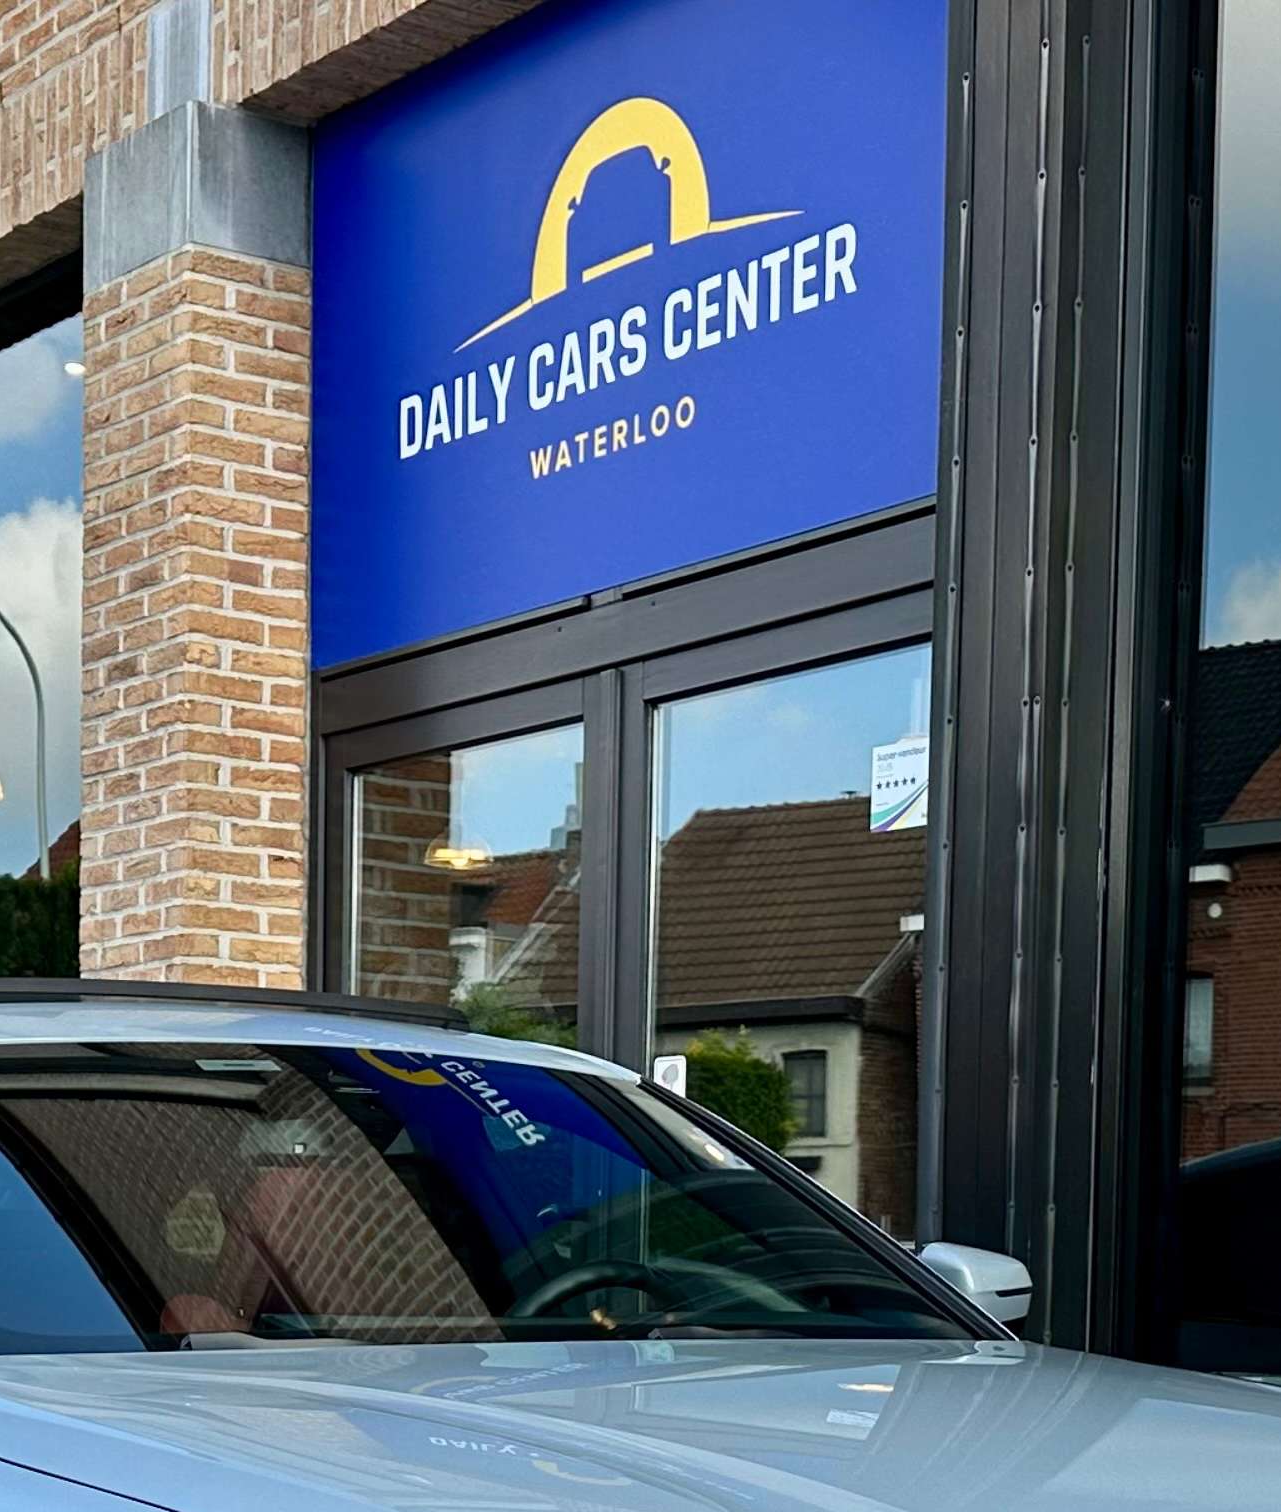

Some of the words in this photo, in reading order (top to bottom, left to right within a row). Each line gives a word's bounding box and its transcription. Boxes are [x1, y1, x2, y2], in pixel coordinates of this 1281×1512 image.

[400, 357, 515, 460] DAILY
[528, 306, 647, 411] CARS
[663, 223, 857, 360] CENTER
[529, 396, 696, 479] WATERLOO
